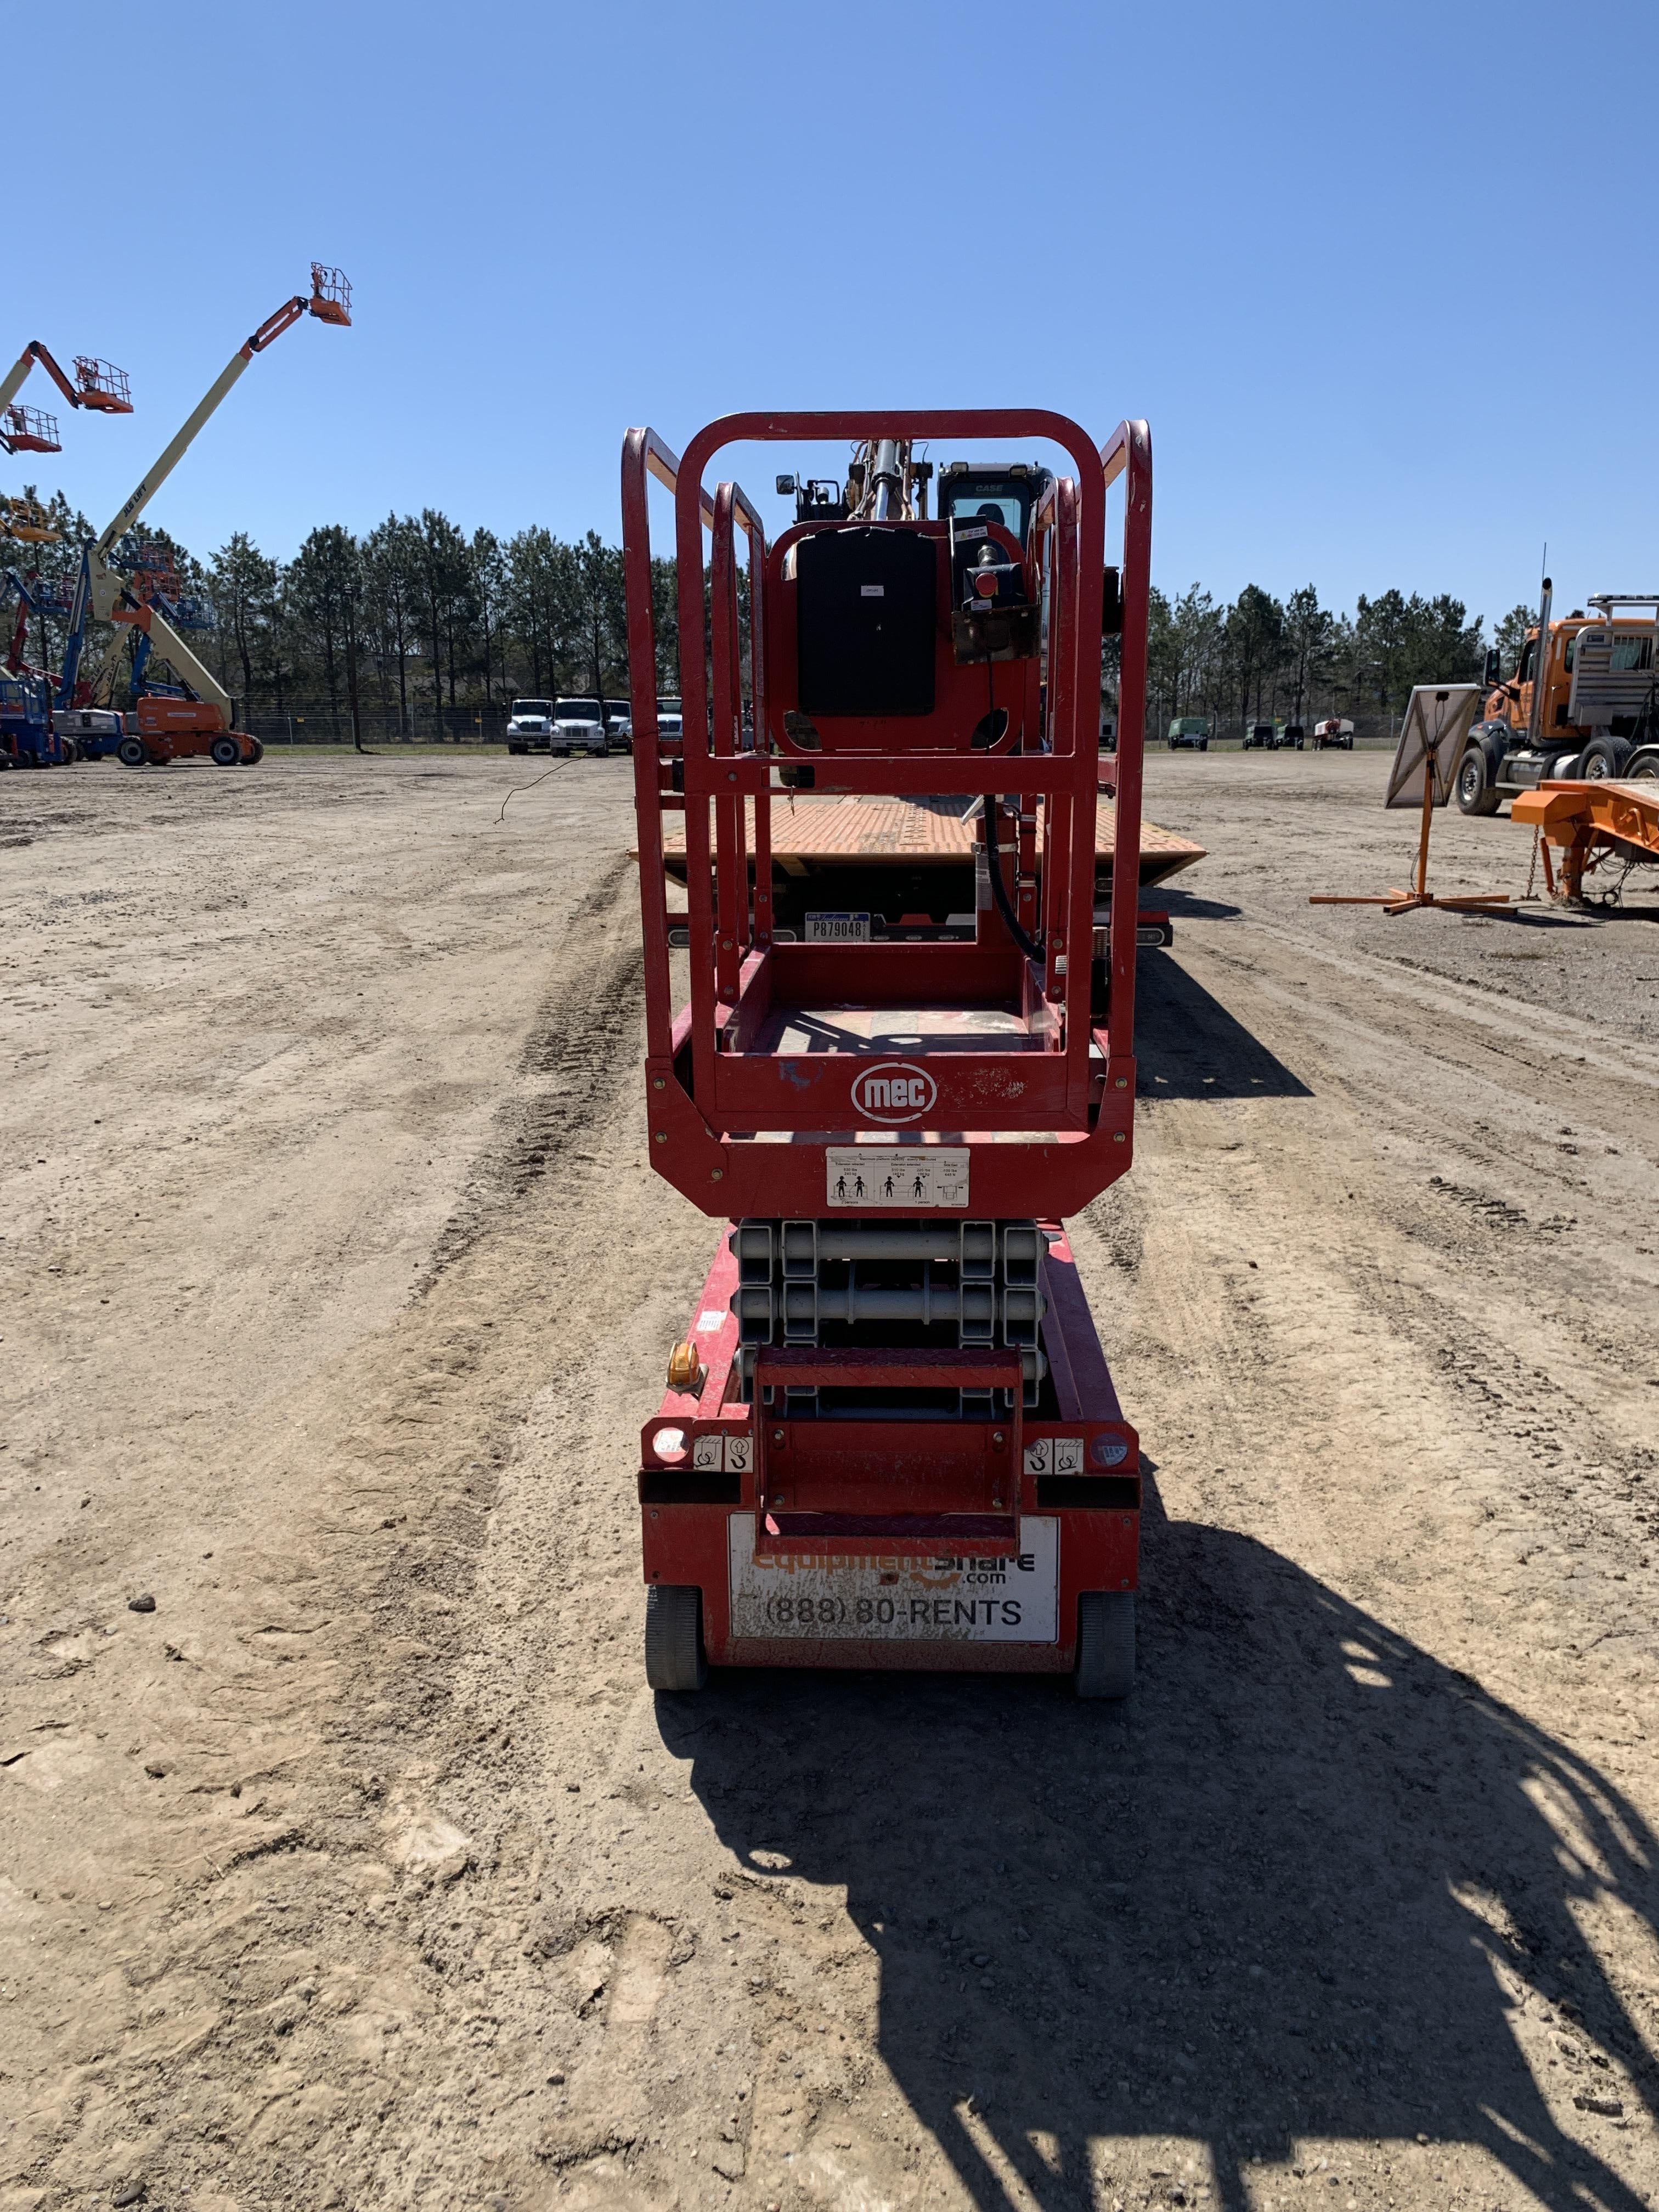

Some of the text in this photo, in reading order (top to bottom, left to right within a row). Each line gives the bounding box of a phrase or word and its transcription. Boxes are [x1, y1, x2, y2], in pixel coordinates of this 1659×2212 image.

[814, 922, 861, 936] P879048
[962, 1573, 1006, 1584] .com
[767, 1598, 1023, 1626] (888) 80-RENTS
